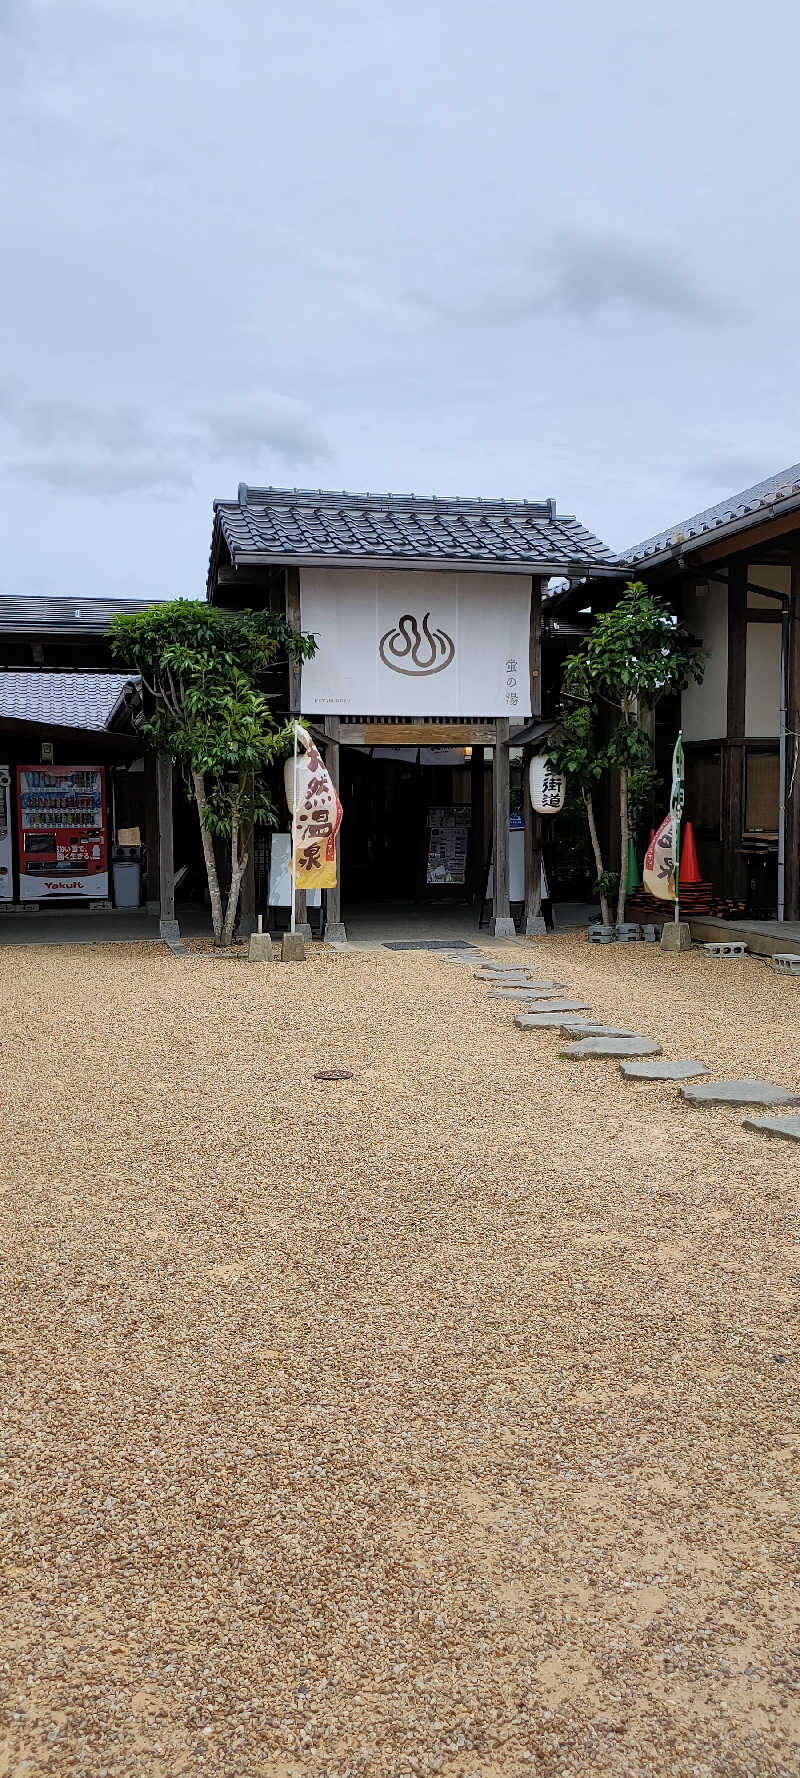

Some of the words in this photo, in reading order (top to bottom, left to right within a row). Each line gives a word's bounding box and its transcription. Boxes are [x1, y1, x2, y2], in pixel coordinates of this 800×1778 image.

[297, 739, 333, 871] 天然温泉
[44, 881, 85, 890] Yakult
